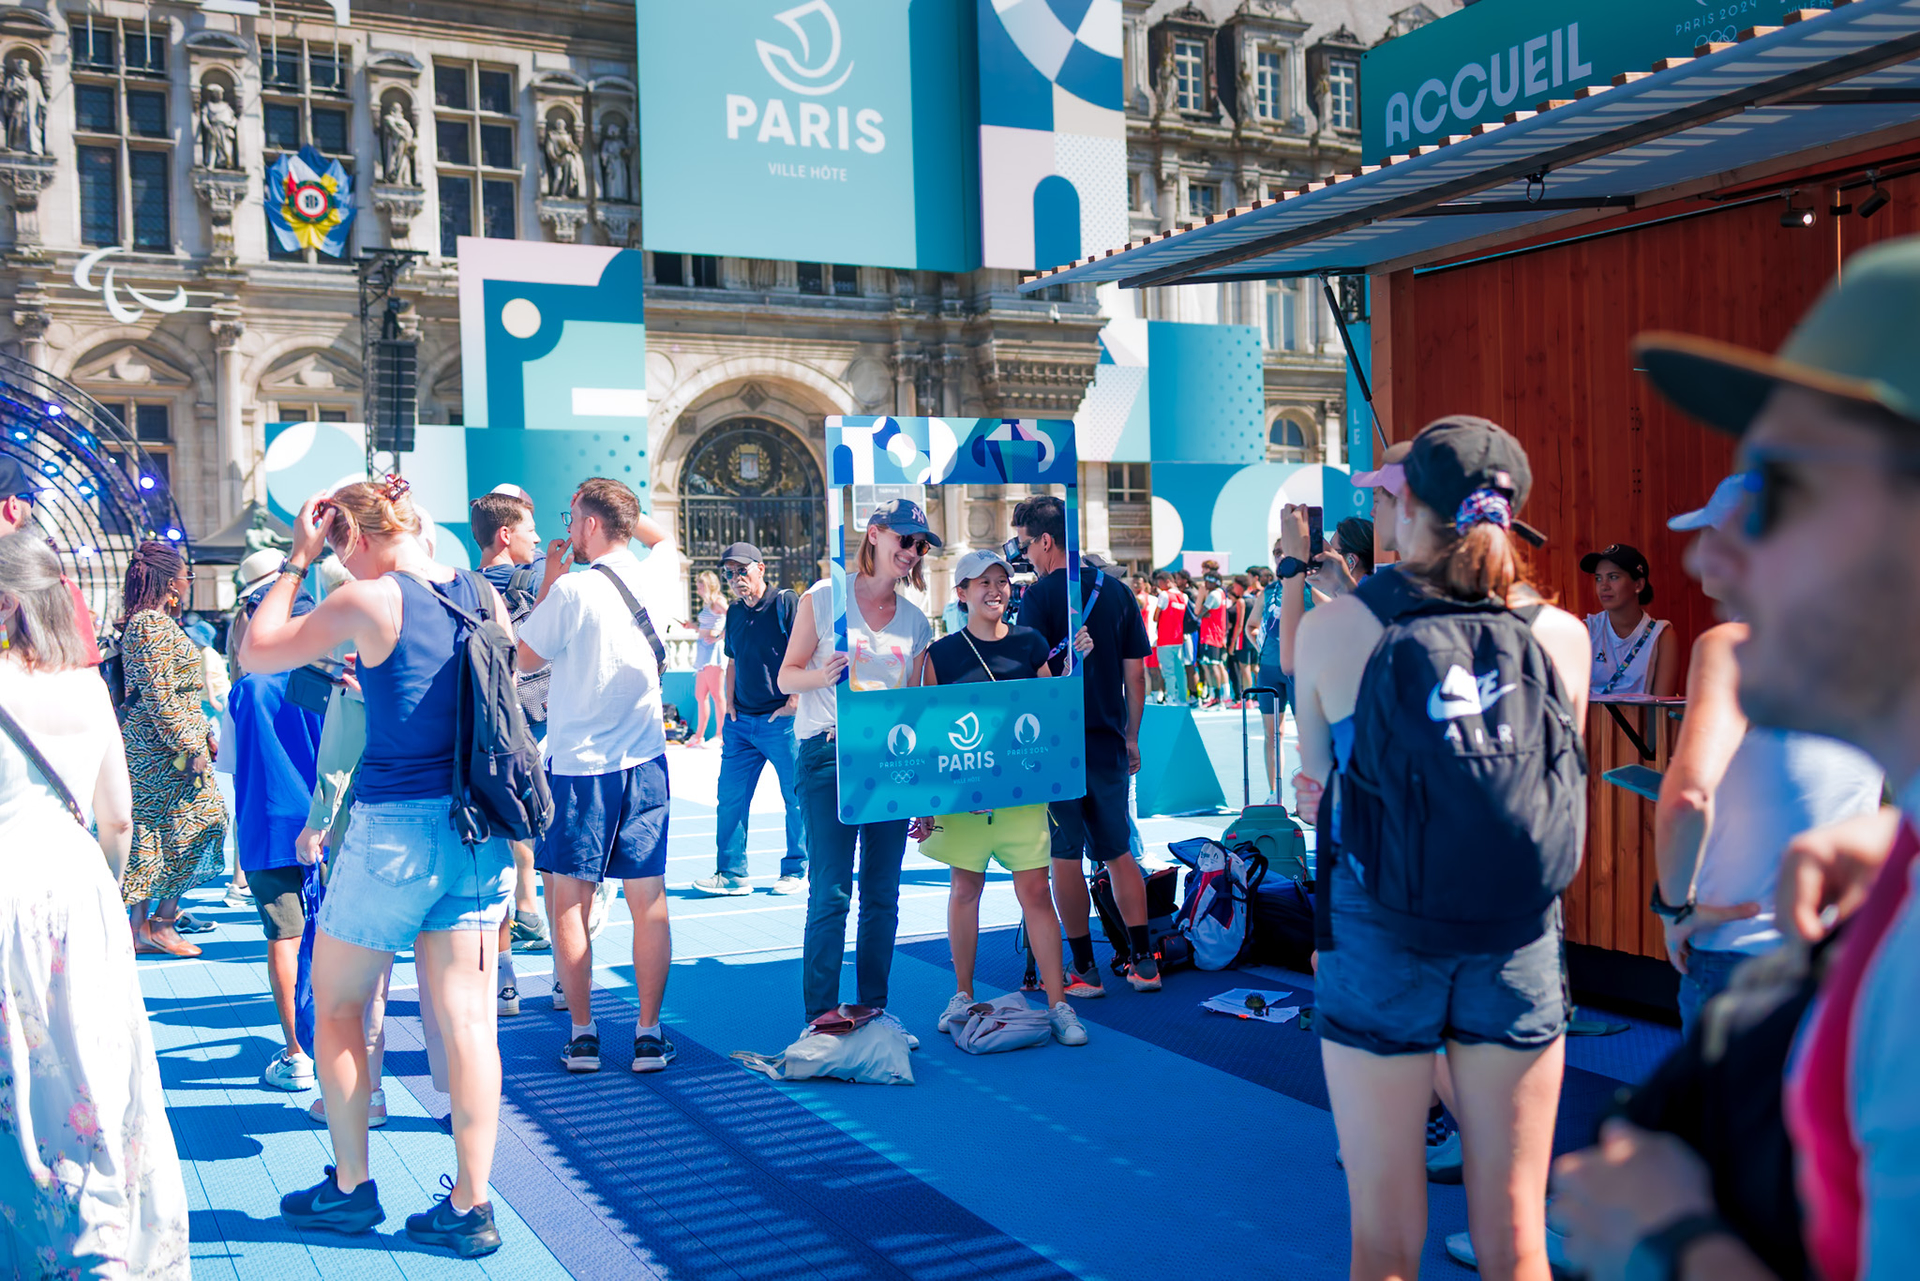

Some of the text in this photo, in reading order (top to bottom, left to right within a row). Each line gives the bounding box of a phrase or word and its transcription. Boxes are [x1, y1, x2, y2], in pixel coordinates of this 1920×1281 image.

[1675, 0, 1757, 36] PARIS 2024
[1386, 22, 1592, 147] ACCUEIL
[725, 93, 886, 155] PARIS
[768, 162, 848, 182] VILLE HÔTE
[1443, 721, 1514, 744] AIR
[938, 750, 995, 773] PARIS
[1006, 746, 1049, 756] PARIS 2024
[879, 758, 926, 769] PARIS 2024
